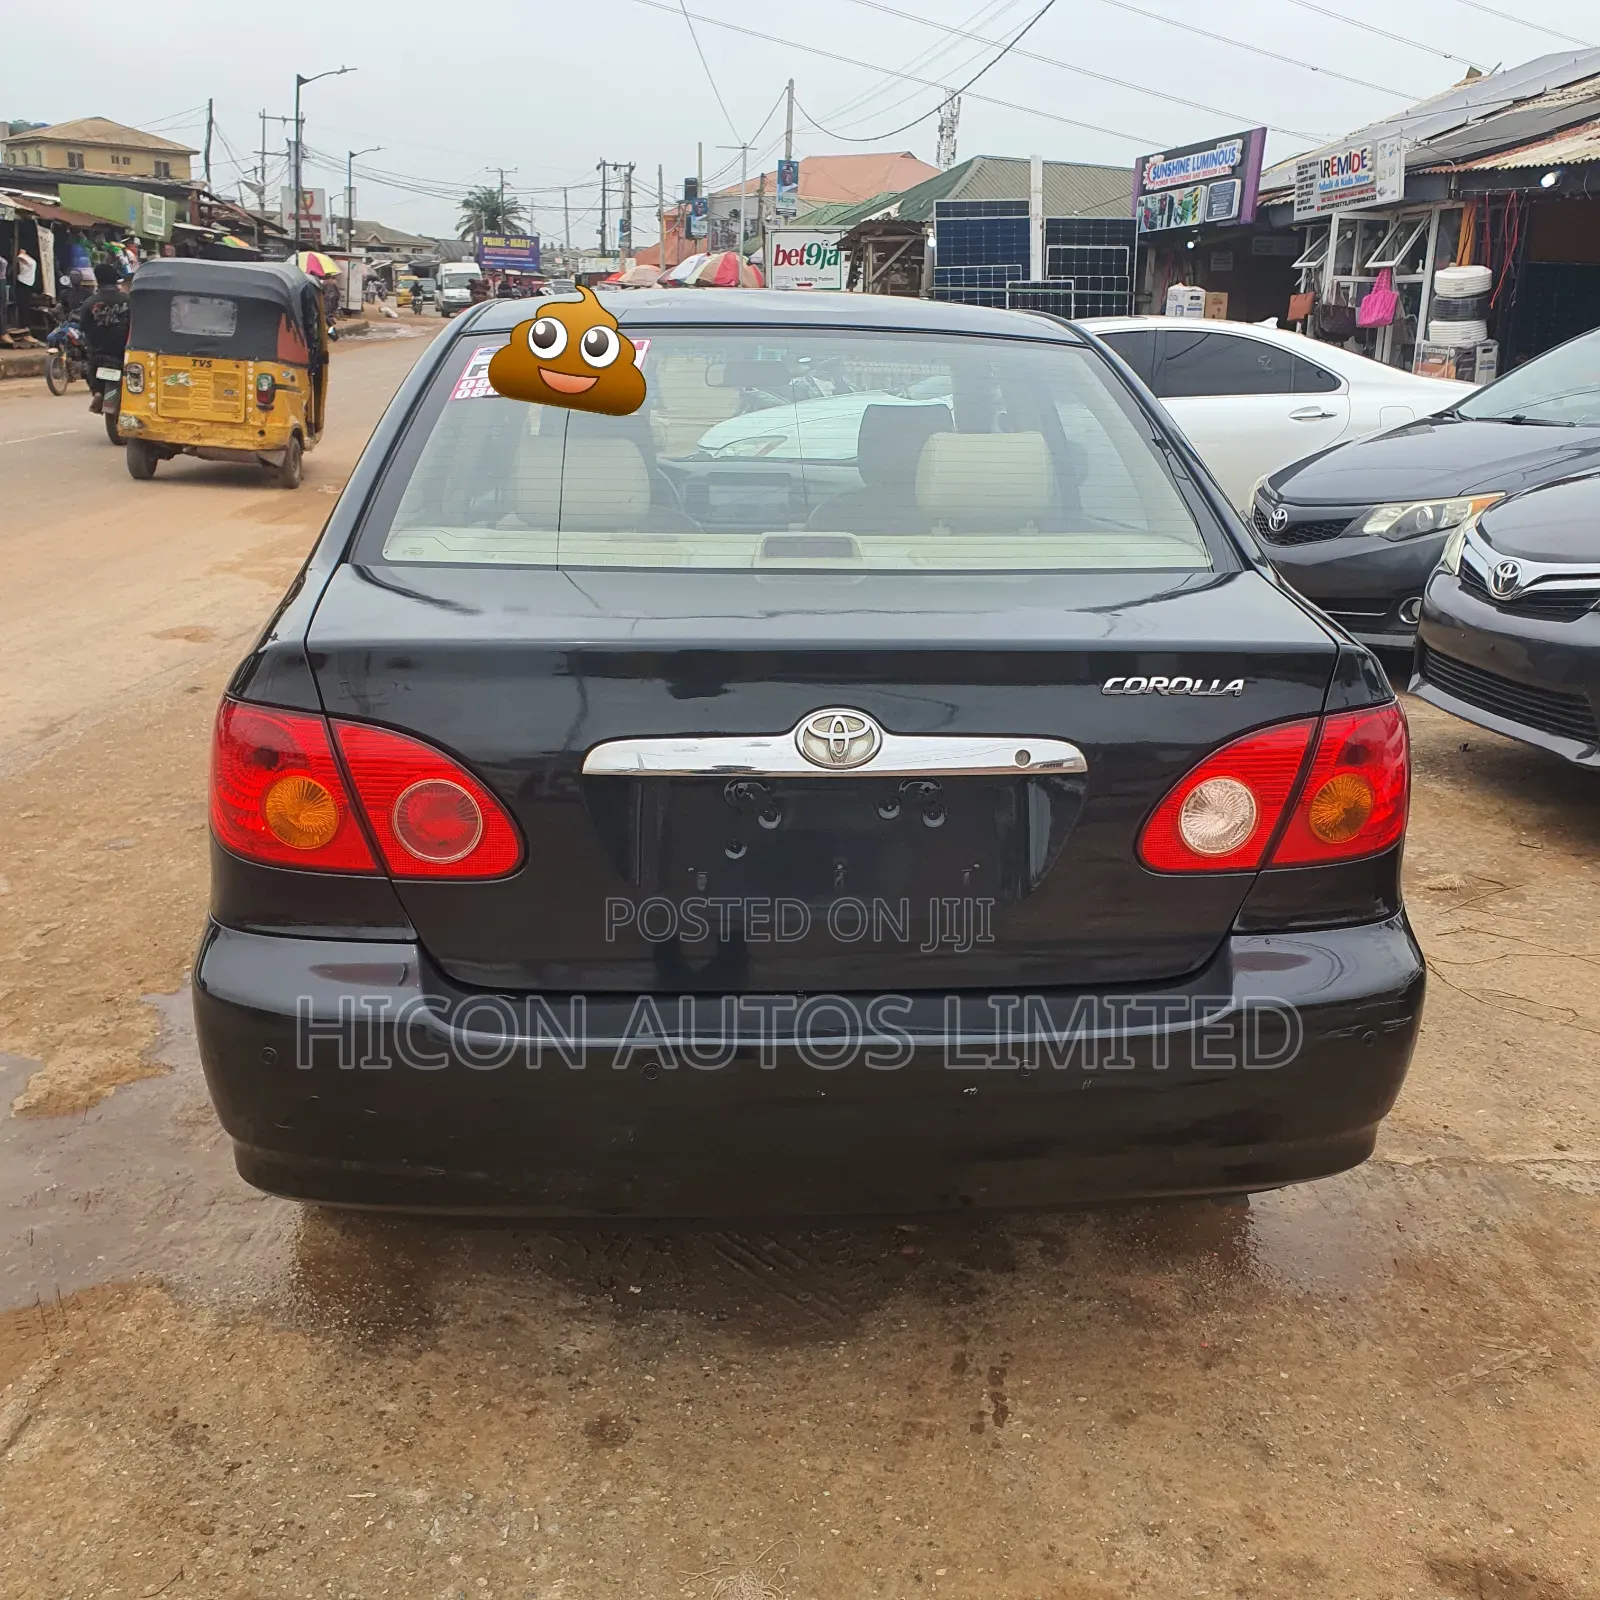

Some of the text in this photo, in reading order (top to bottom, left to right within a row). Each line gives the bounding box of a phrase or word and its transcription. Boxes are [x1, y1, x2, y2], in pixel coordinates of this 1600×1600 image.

[1152, 147, 1236, 180] SUNSHINE LUMINOUS
[1320, 147, 1367, 178] IREMIDE
[1169, 173, 1191, 183] SOLUTIONS
[1318, 174, 1370, 191] Adult & Kids Store
[773, 241, 839, 270] bet9ja
[191, 358, 213, 368] TVS
[1101, 676, 1244, 697] COROLLA
